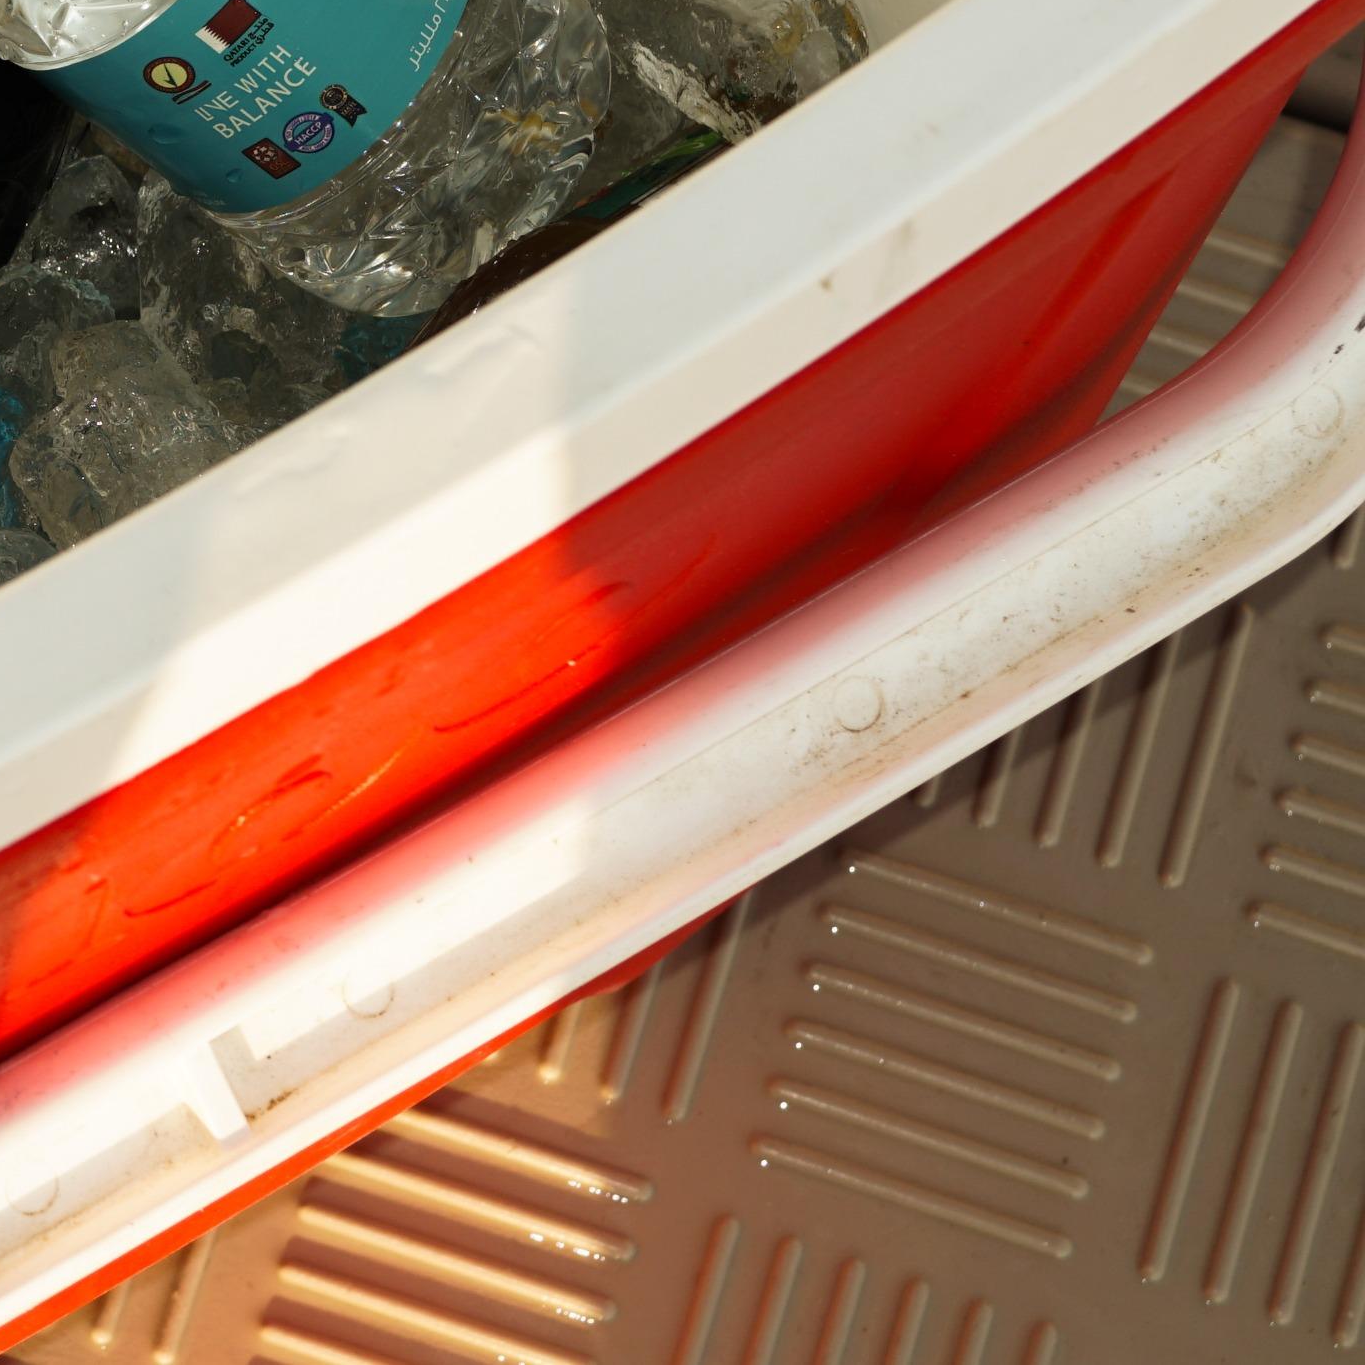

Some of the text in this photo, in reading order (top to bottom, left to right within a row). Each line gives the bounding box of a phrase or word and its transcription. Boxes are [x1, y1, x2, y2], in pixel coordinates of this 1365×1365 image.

[221, 36, 250, 63] QATARI
[193, 86, 240, 125] LIVE
[232, 40, 292, 99] WITH
[211, 52, 318, 142] BALANCE
[293, 119, 323, 146] HACCP
